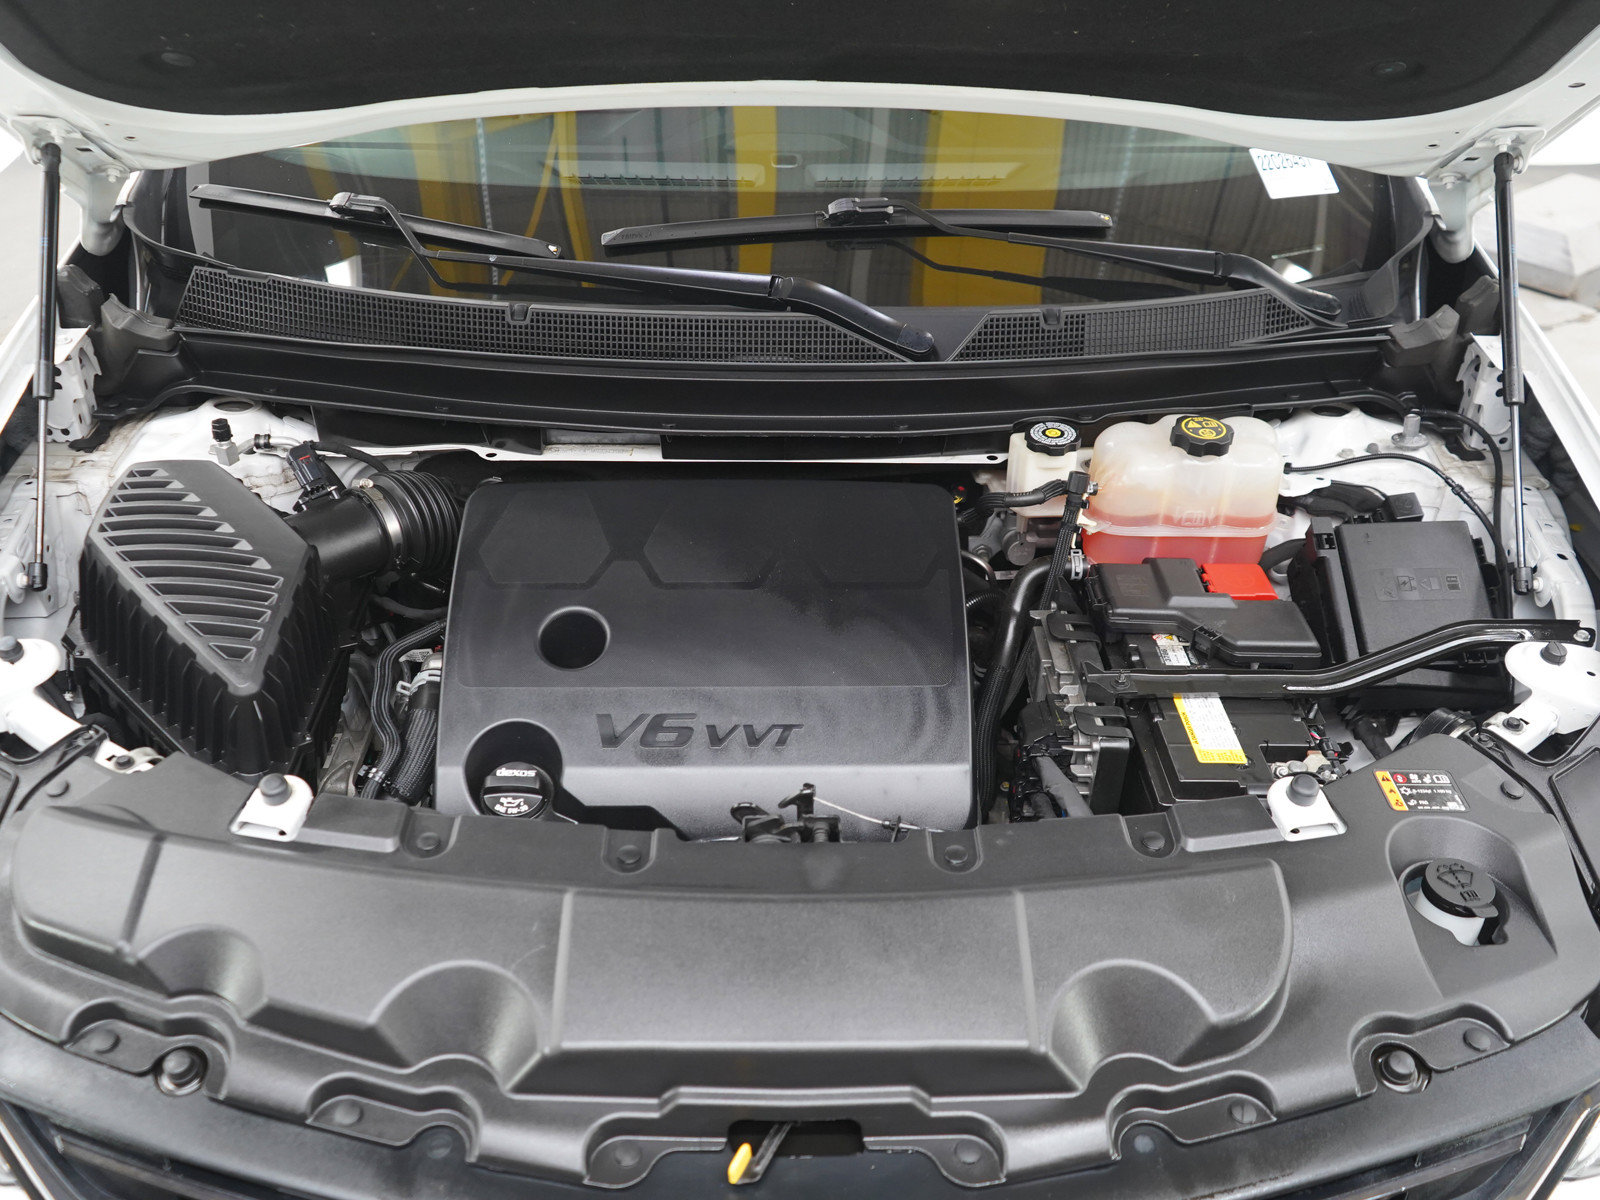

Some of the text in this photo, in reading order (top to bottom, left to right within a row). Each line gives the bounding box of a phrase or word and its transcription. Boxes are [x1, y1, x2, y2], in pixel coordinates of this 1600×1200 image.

[595, 713, 804, 749] V6 VVT
[496, 767, 537, 777] dexos
